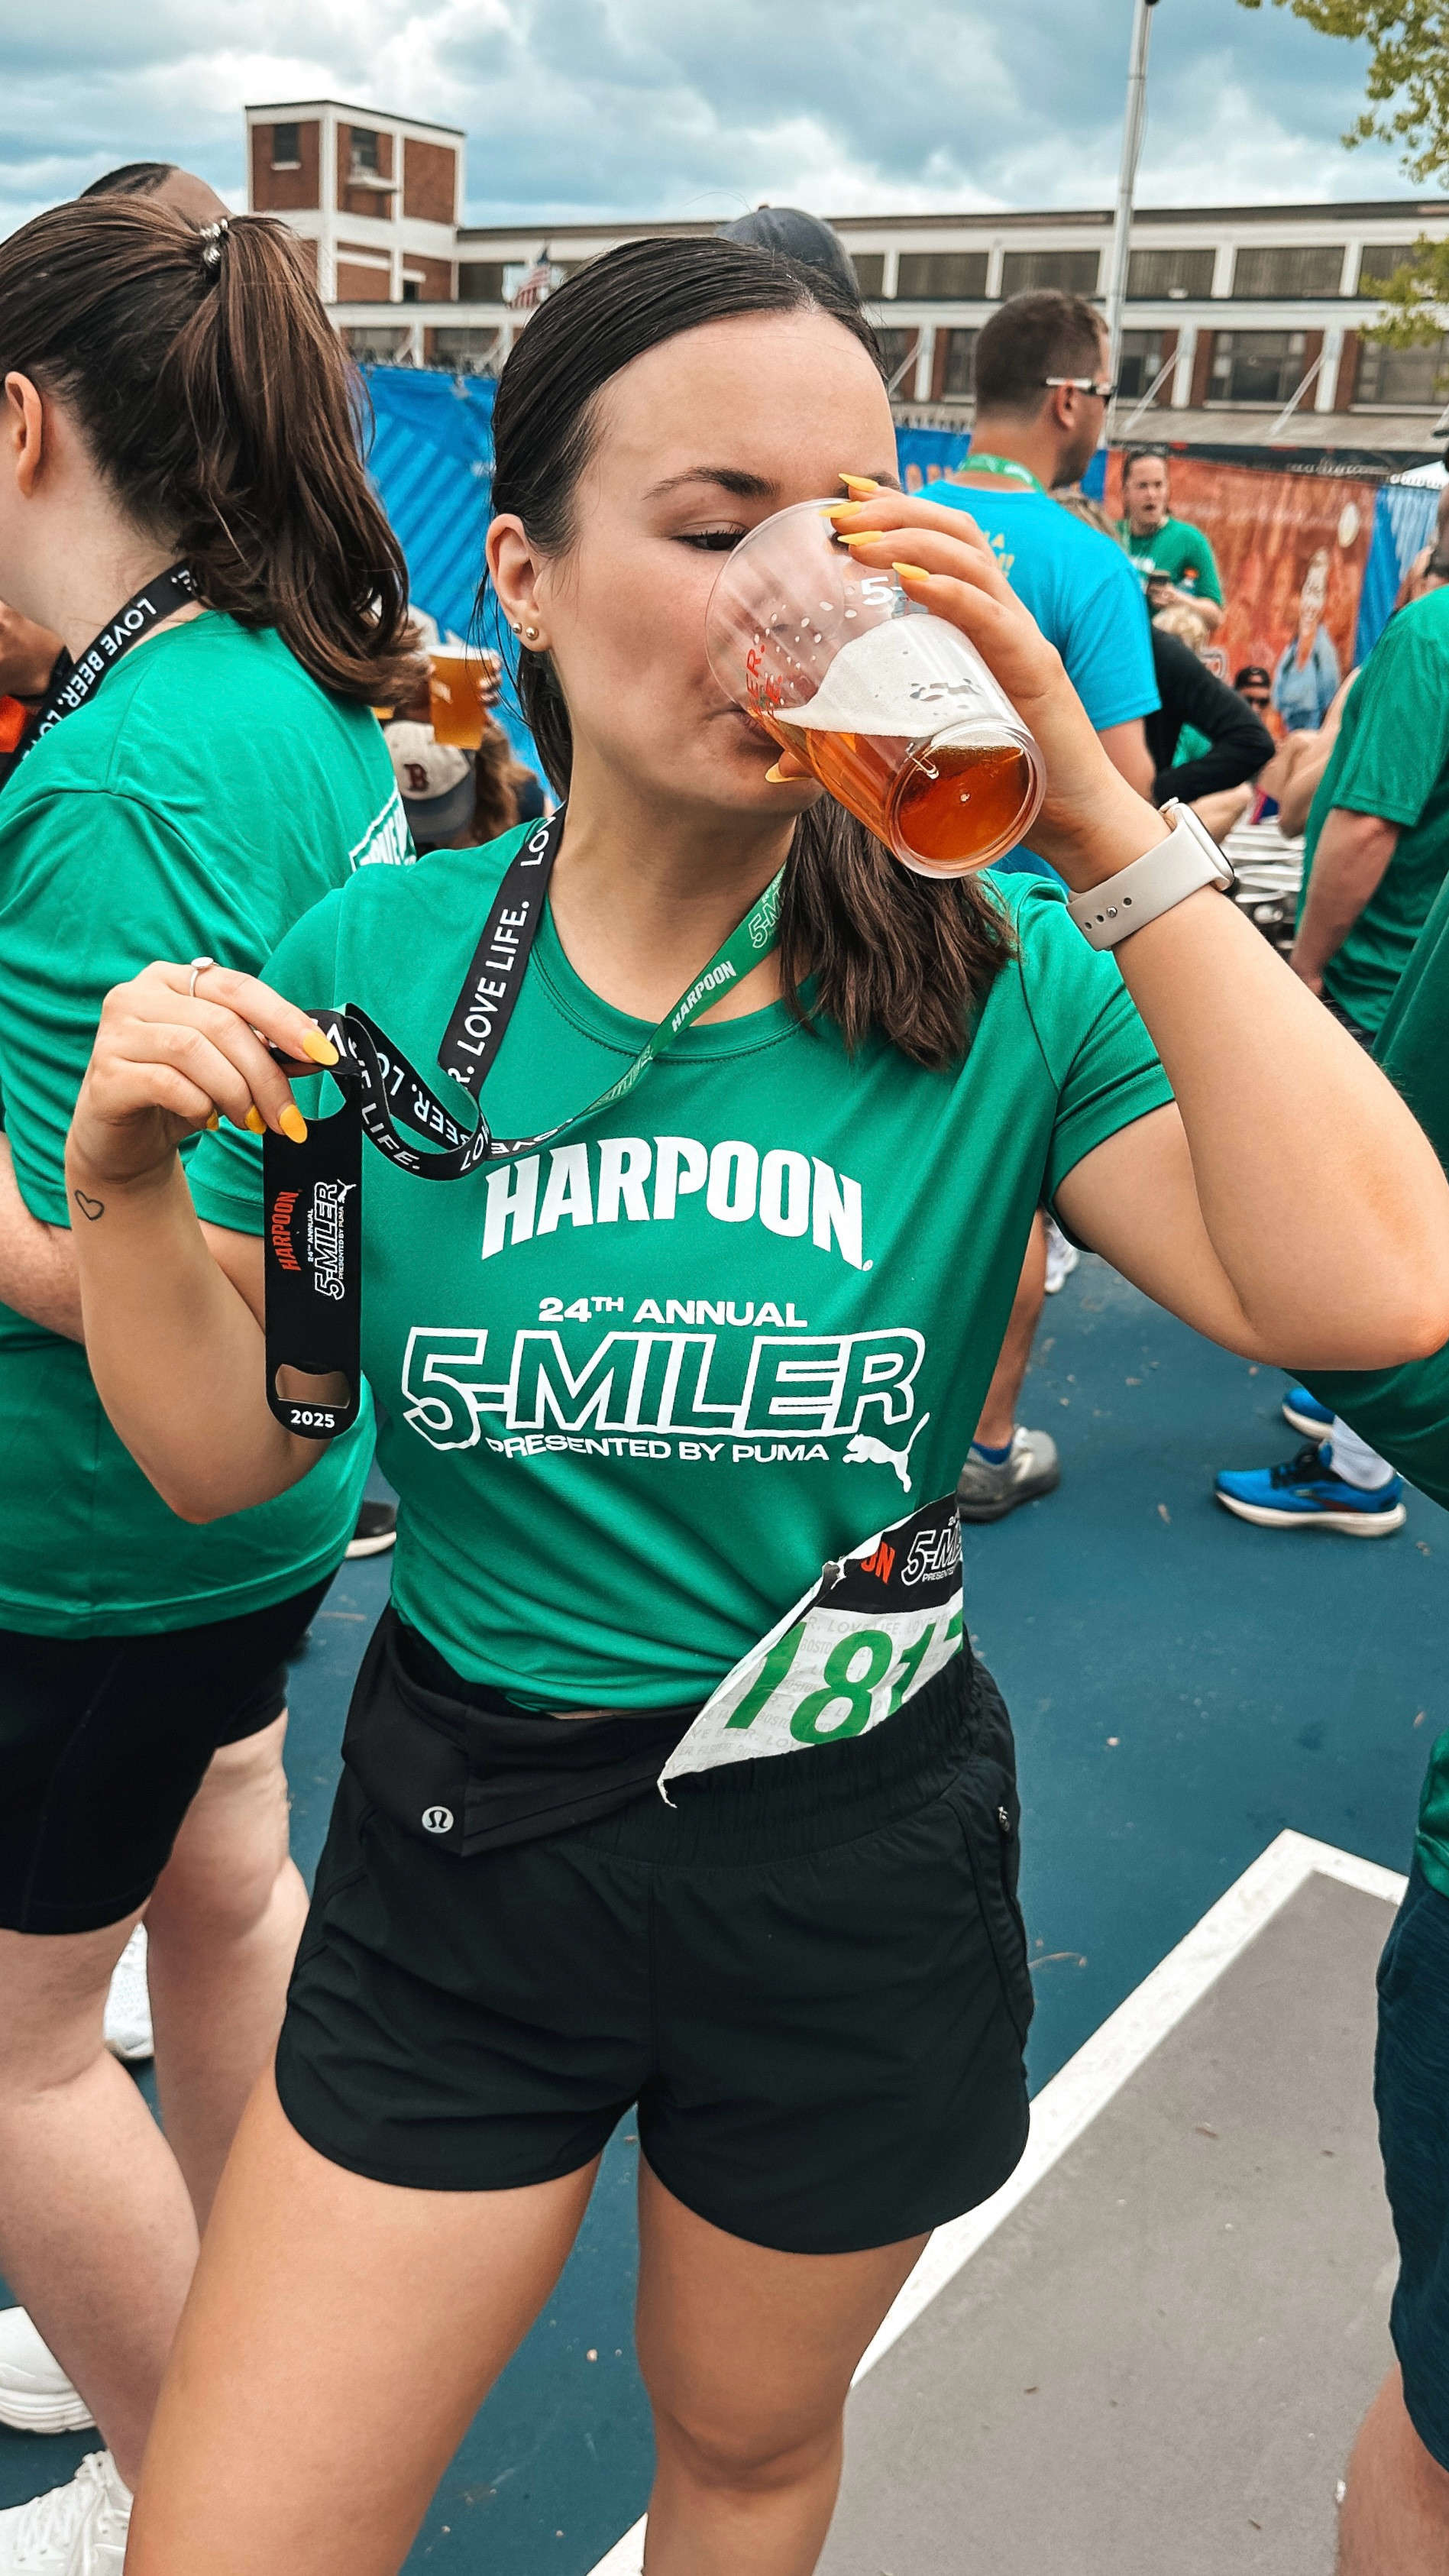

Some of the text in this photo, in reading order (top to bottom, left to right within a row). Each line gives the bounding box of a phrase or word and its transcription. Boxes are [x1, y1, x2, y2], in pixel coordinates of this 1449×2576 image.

[100, 597, 157, 656] LOVE
[57, 650, 105, 707] BEER.
[457, 977, 508, 1057] LOVE
[485, 901, 530, 971] LIFE.
[671, 960, 737, 1033] HARPOON
[361, 1102, 420, 1170] LIFE.
[272, 1190, 302, 1271] HARPOON
[481, 1136, 864, 1271] HARPOON
[314, 1182, 345, 1300] 5-MILER
[539, 1296, 807, 1327] 24TH ANNUAL
[290, 1409, 335, 1429] 2025
[402, 1327, 926, 1450] 5-MILER
[486, 1433, 830, 1462] PRESENTED BY PUMA
